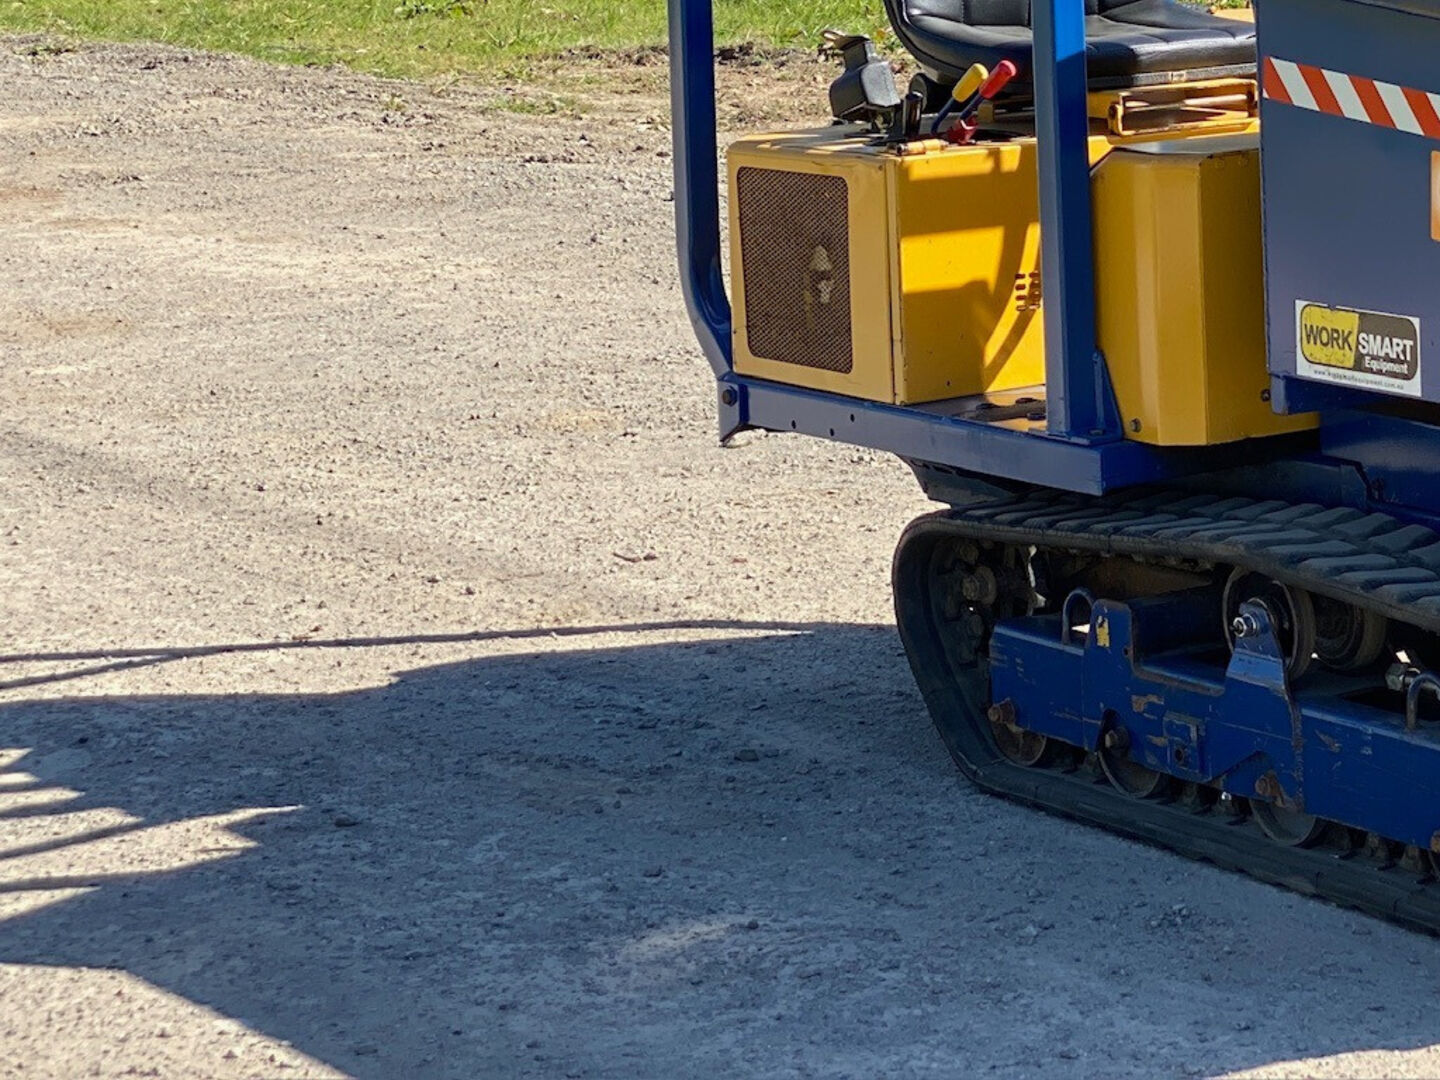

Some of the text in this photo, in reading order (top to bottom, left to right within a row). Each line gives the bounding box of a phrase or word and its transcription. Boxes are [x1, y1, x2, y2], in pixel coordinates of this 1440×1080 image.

[1304, 323, 1414, 361] WORK SMART
[1364, 355, 1408, 374] Equipment
